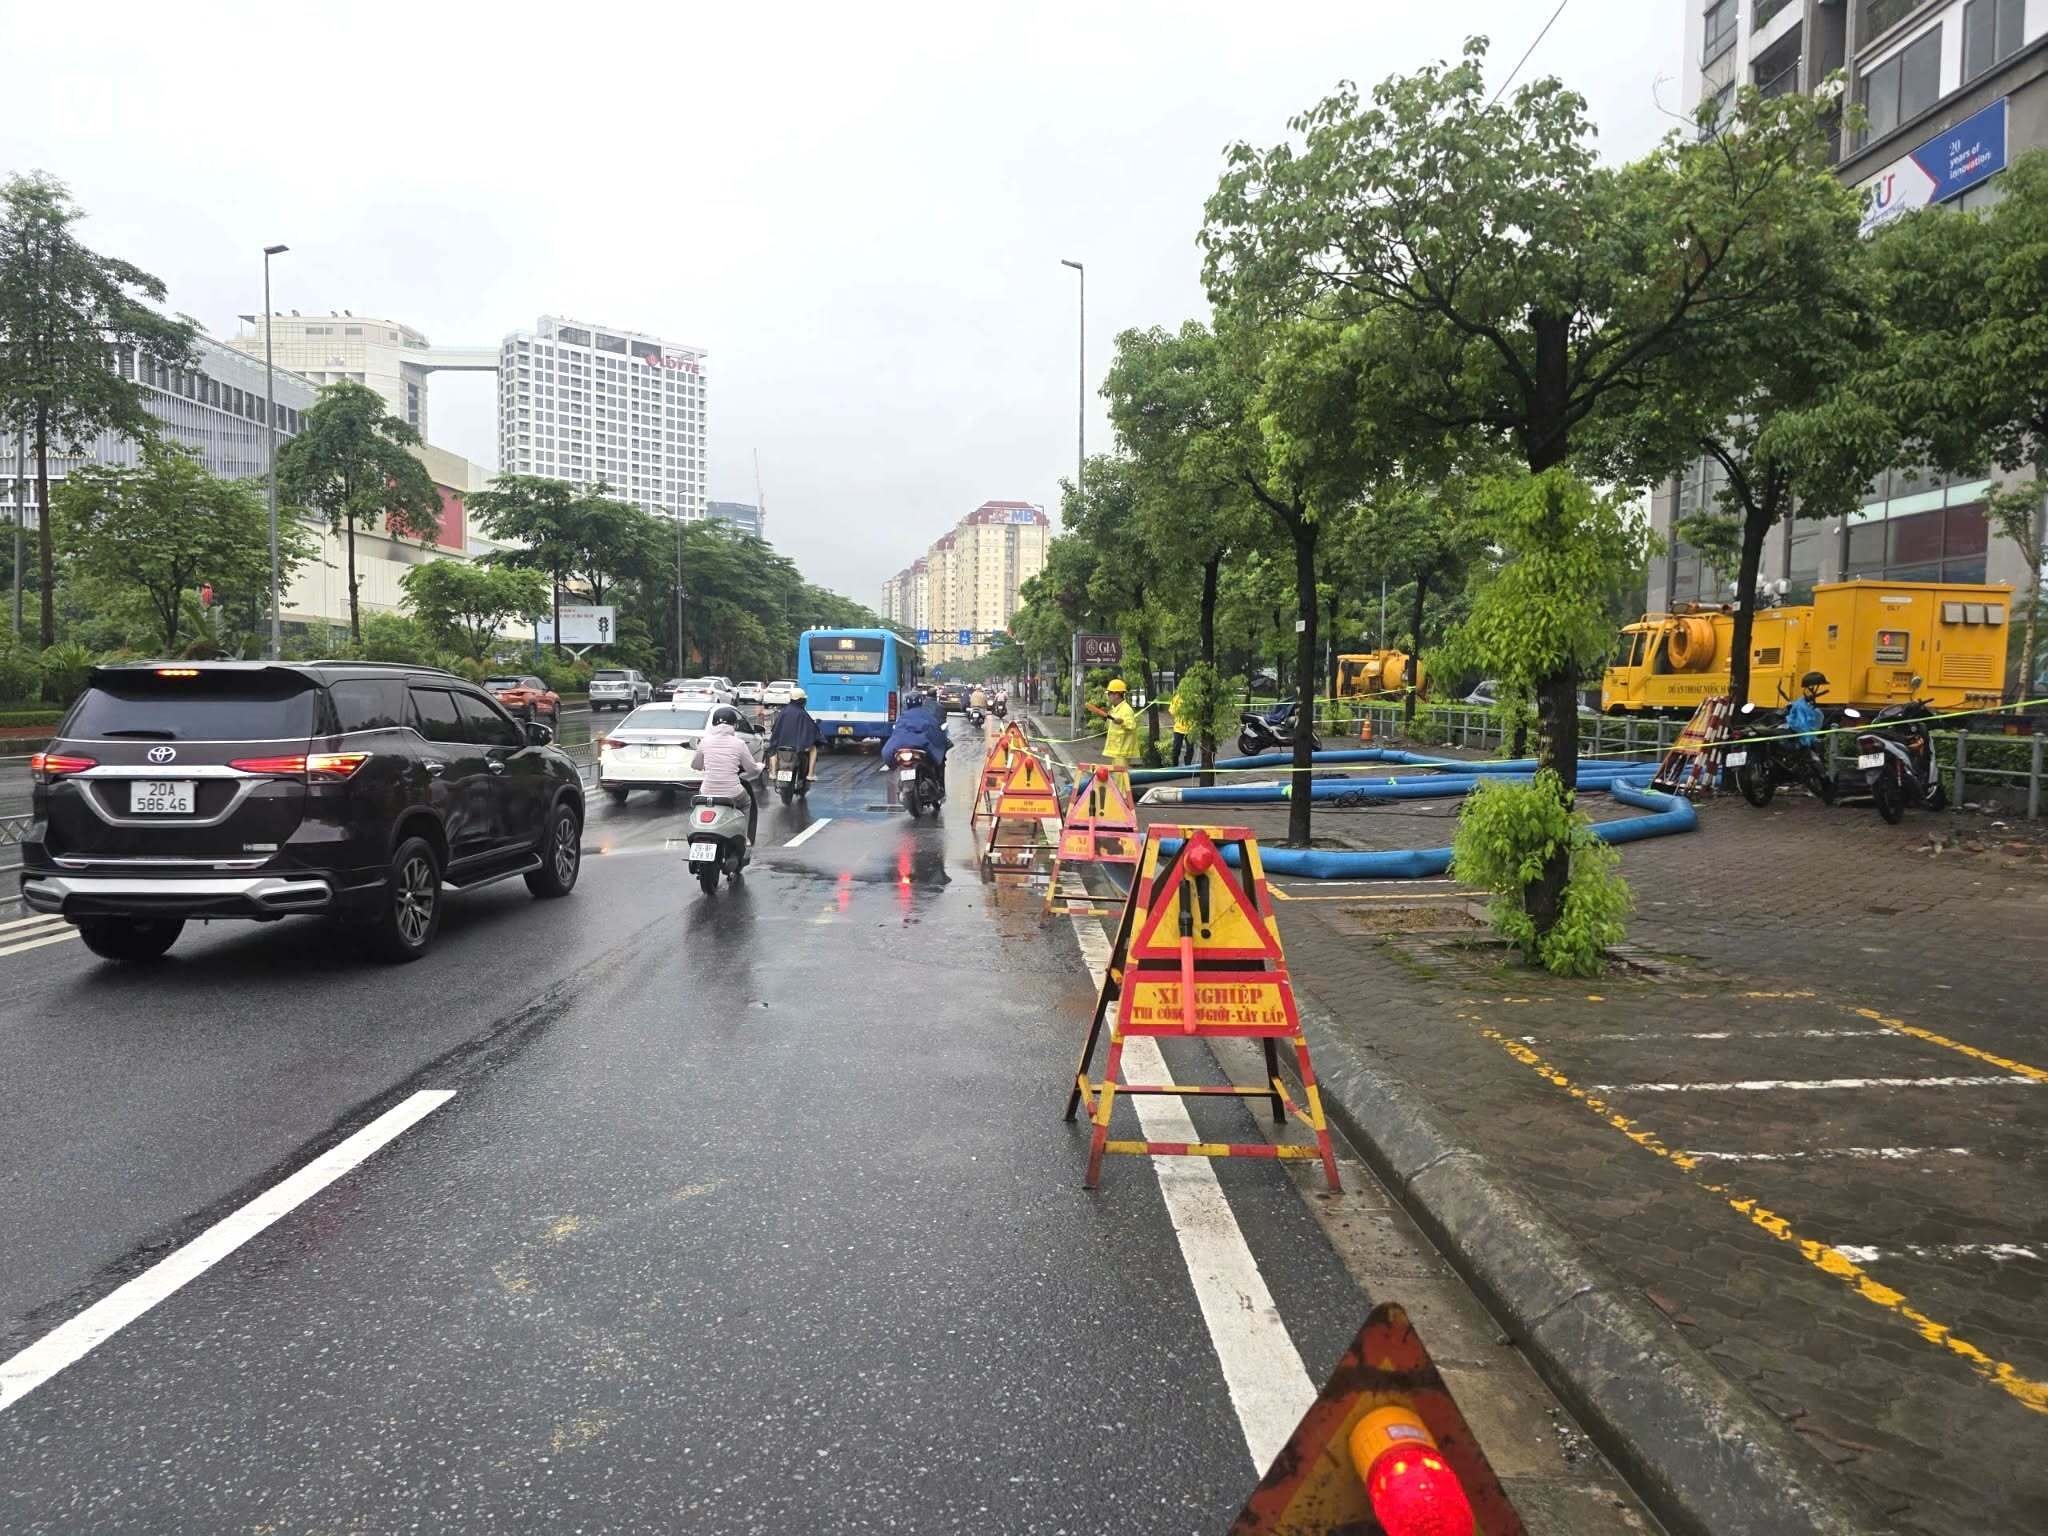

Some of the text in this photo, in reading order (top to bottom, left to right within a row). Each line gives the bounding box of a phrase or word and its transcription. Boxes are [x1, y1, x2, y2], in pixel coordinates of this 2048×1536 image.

[1949, 139, 1961, 157] 20
[1950, 141, 1980, 169] years of
[1950, 150, 1991, 180] innovation
[1012, 508, 1034, 523] MB
[1098, 641, 1117, 654] GIA
[149, 783, 175, 796] 20A
[136, 797, 187, 811] 586.46
[1133, 1006, 1153, 1020] THI
